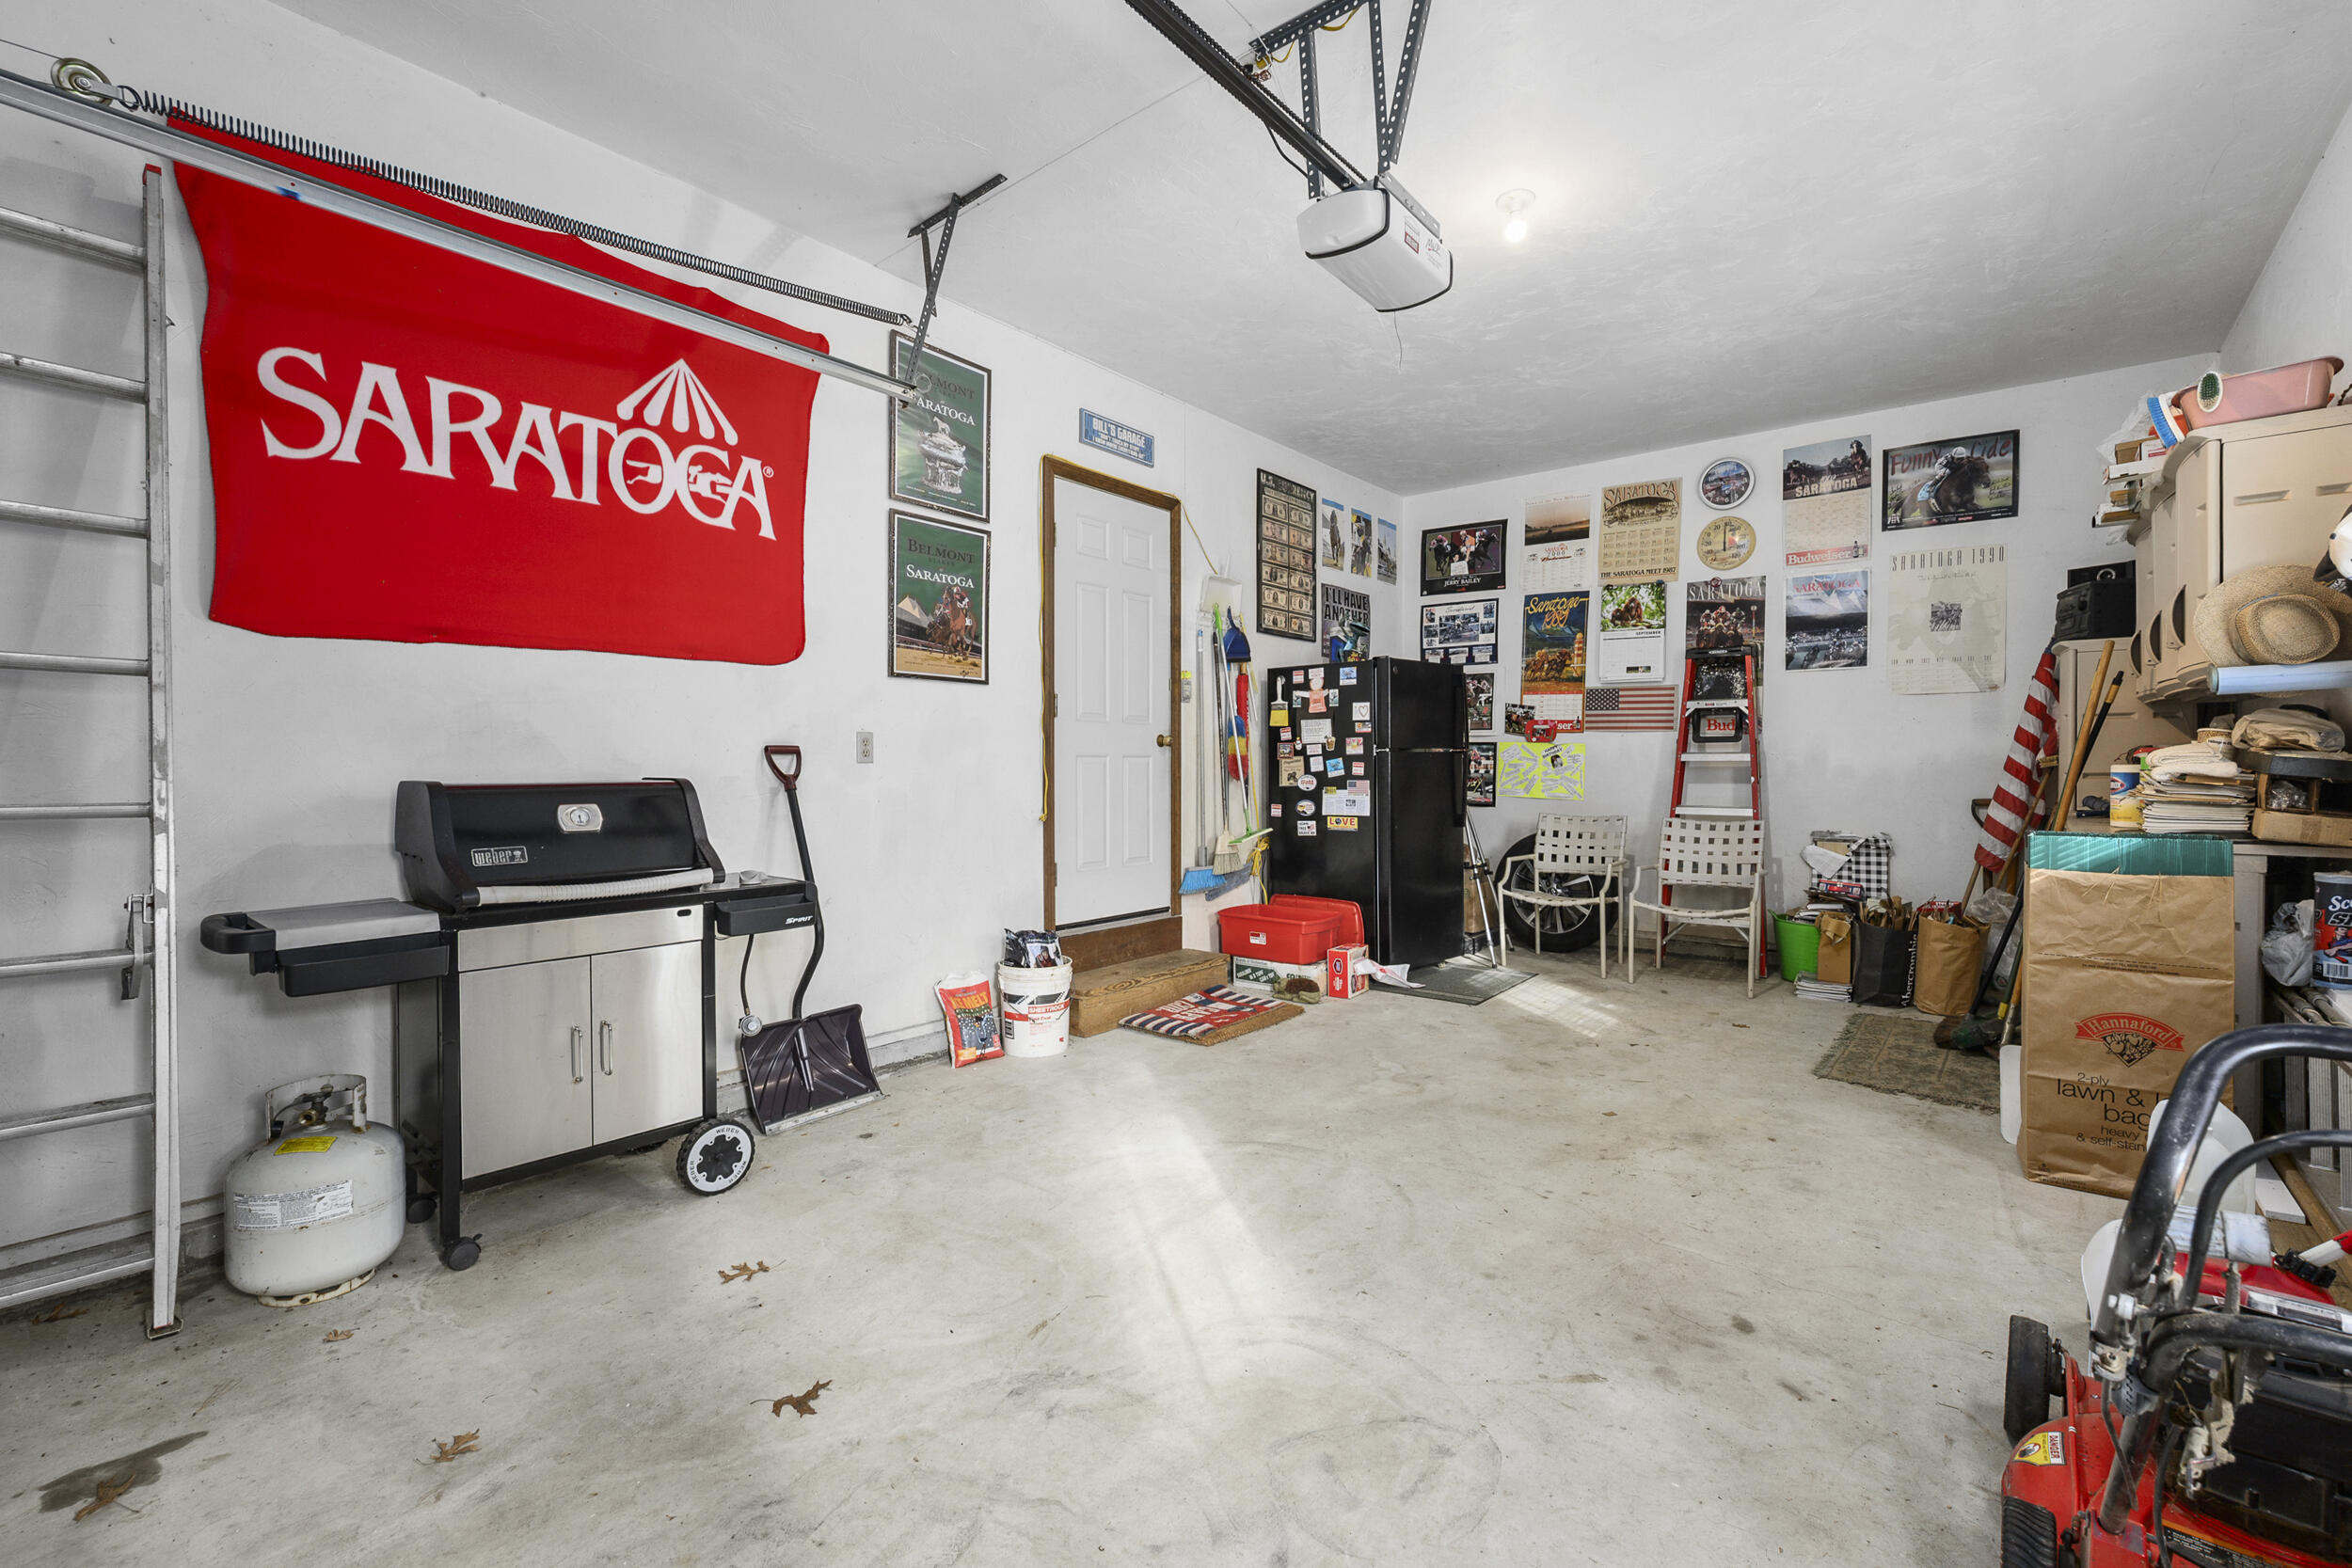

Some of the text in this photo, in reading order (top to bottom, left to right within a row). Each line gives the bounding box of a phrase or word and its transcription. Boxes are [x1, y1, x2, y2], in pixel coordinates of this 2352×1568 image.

[916, 397, 976, 426] ARATOGA
[256, 346, 776, 542] SARATOGA
[1117, 426, 1146, 449] GARAGE
[1890, 447, 1943, 476] Funny
[1603, 481, 1679, 512] SARATOGA
[1795, 477, 1858, 498] SARATOGA
[907, 538, 976, 564] BELMONT
[1788, 549, 1851, 564] Budweiser
[1892, 546, 2005, 572] SARATOGA 1990
[906, 564, 976, 589] SARATOGA
[1443, 579, 1459, 588] JERRY
[1794, 578, 1861, 594] SARATOGA
[1325, 585, 1369, 611] I'LL HAVE
[1688, 581, 1764, 602] SARATOGA
[1527, 595, 1581, 614] Saratoga
[1707, 719, 1736, 731] Bud
[473, 848, 513, 865] weber
[785, 915, 813, 925] SPIRIT
[1900, 933, 1918, 1006] Abercrombie
[1029, 1004, 1065, 1015] SHEETROCK
[2090, 1017, 2173, 1040] Hannaford
[2077, 1072, 2109, 1086] 2-ply
[2057, 1078, 2145, 1108] lawn &
[2104, 1102, 2152, 1132] bag
[2076, 1132, 2086, 1142] &
[2090, 1135, 2147, 1152] self-stan
[2100, 1125, 2140, 1141] heavy
[2049, 1434, 2060, 1459] DANGER
